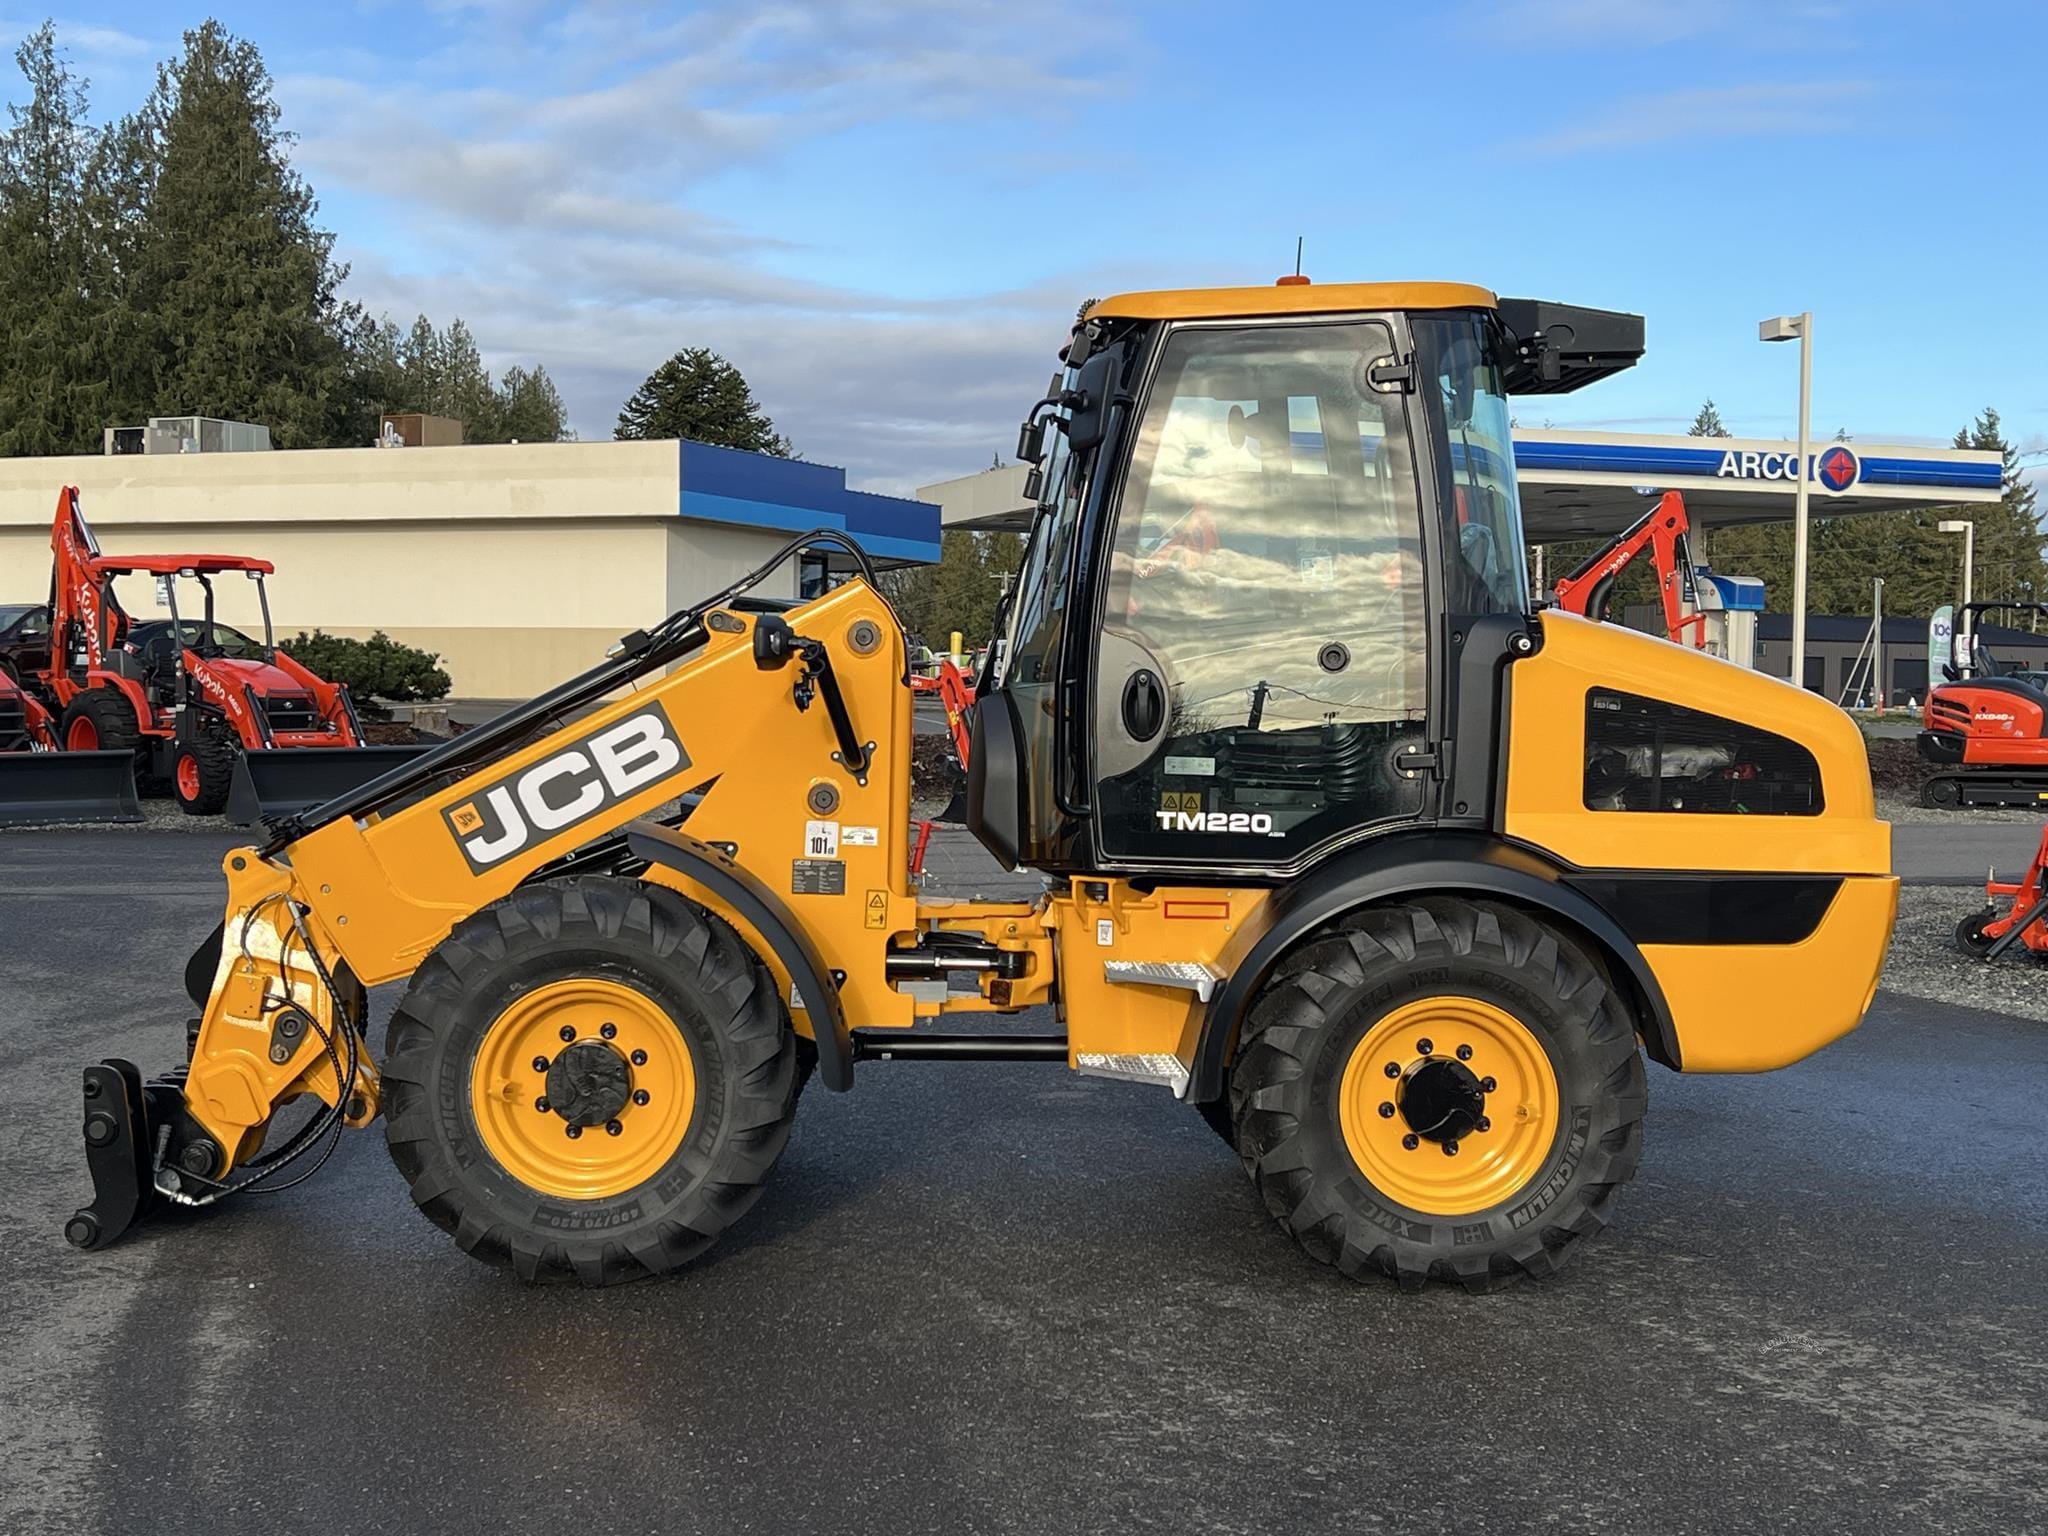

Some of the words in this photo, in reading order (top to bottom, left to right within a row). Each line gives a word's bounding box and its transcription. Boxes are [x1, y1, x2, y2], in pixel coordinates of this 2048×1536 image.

[1934, 624, 1951, 637] 10¢
[194, 663, 225, 701] Kubota
[465, 714, 681, 864] JCB
[1156, 811, 1272, 833] TM220
[810, 837, 828, 854] 101
[1513, 1131, 1586, 1229] MICHELIN
